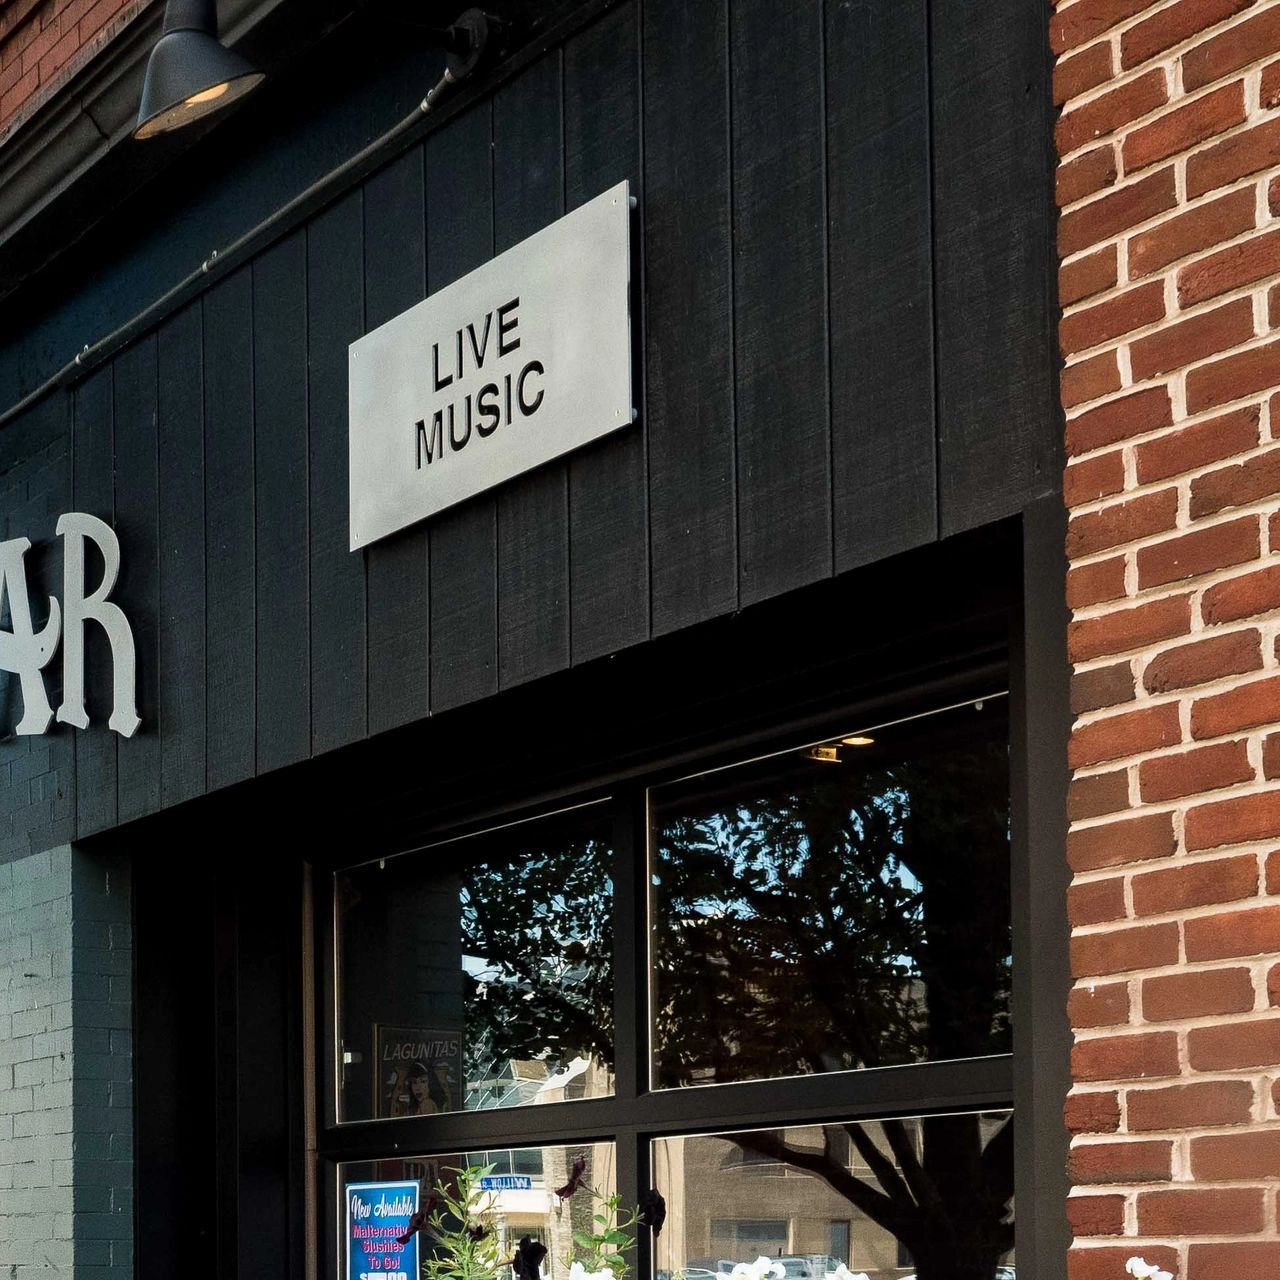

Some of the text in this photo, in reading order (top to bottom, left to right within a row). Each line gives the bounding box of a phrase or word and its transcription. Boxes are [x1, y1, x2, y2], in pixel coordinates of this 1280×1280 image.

[432, 296, 521, 392] LIVE
[414, 360, 545, 470] MUSIC
[383, 1040, 458, 1061] LAGUNITAS
[351, 1193, 414, 1220] New Available
[353, 1224, 408, 1239] Malternativ
[362, 1240, 405, 1253] Slushies
[368, 1255, 401, 1270] To Go!
